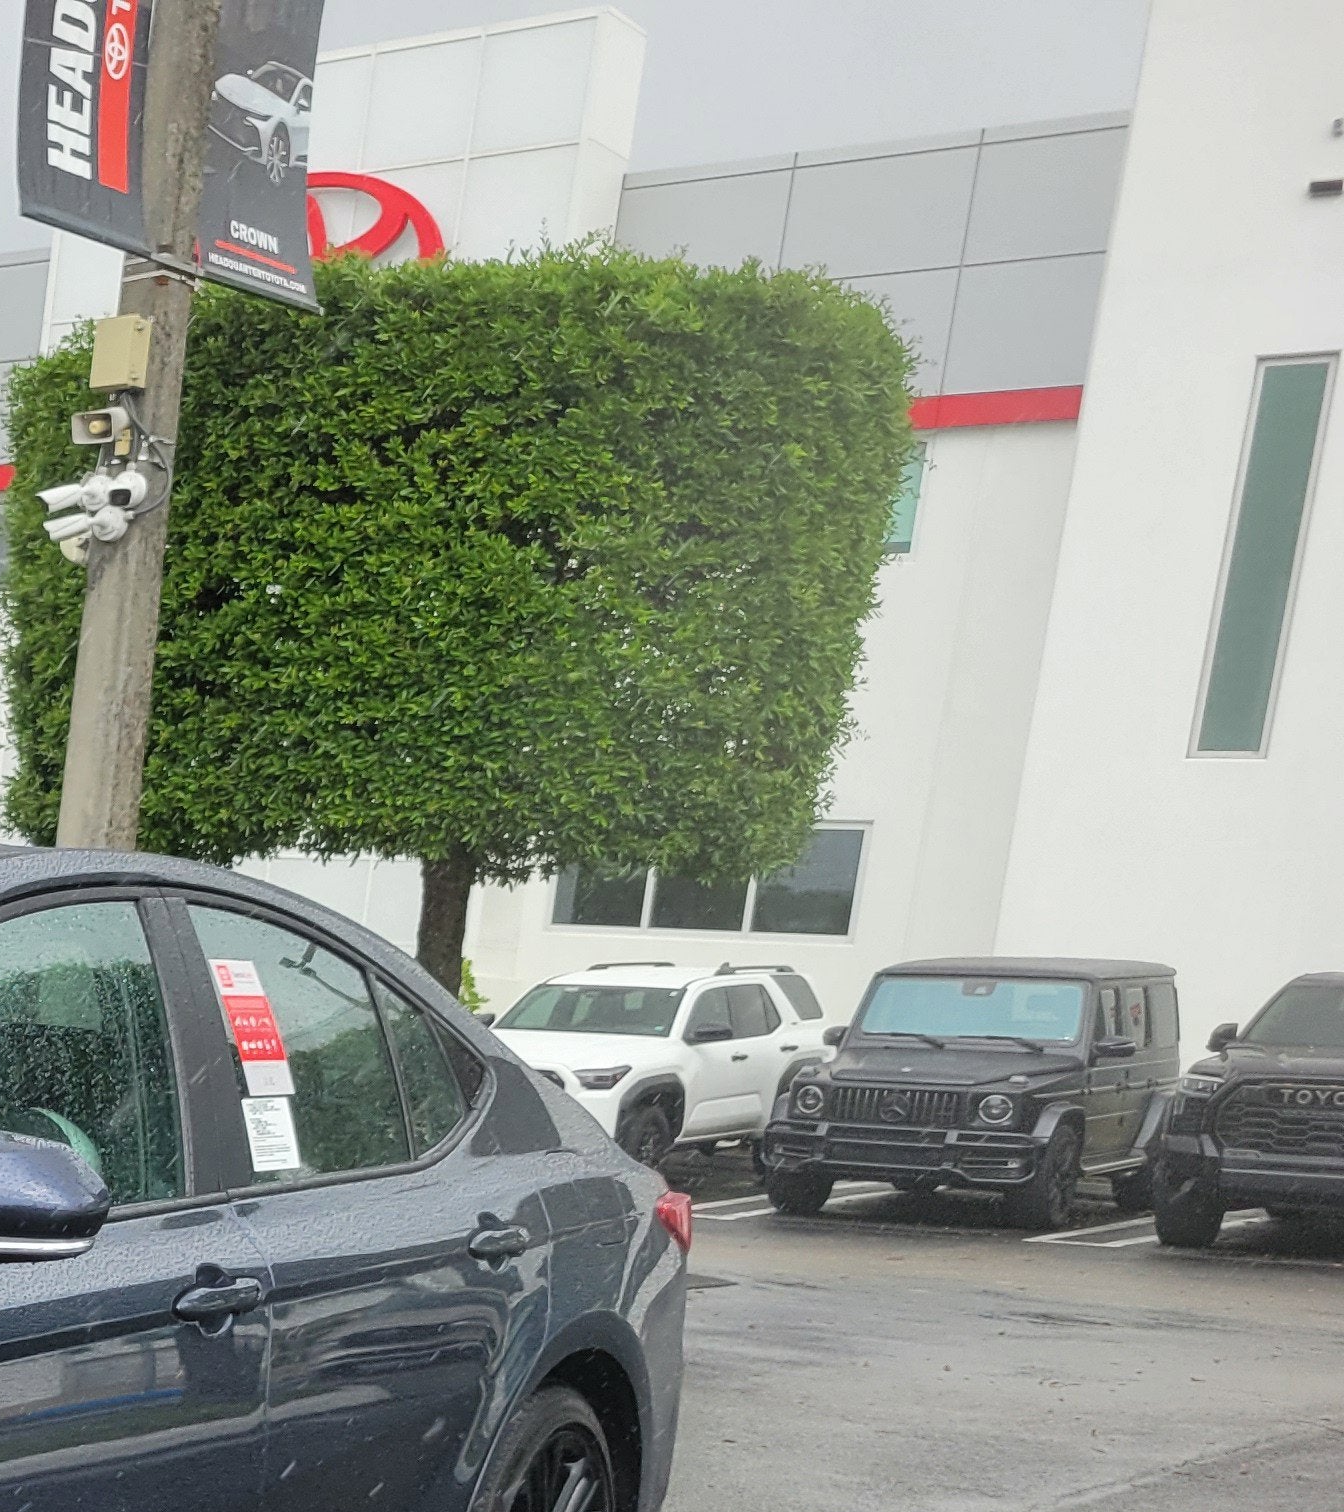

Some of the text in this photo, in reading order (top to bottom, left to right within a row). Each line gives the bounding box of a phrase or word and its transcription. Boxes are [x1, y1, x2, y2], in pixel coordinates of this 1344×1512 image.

[47, 0, 97, 180] HEAD
[230, 219, 279, 255] CROWN
[208, 252, 307, 294] HEADQUARTERTOYOTA.COM
